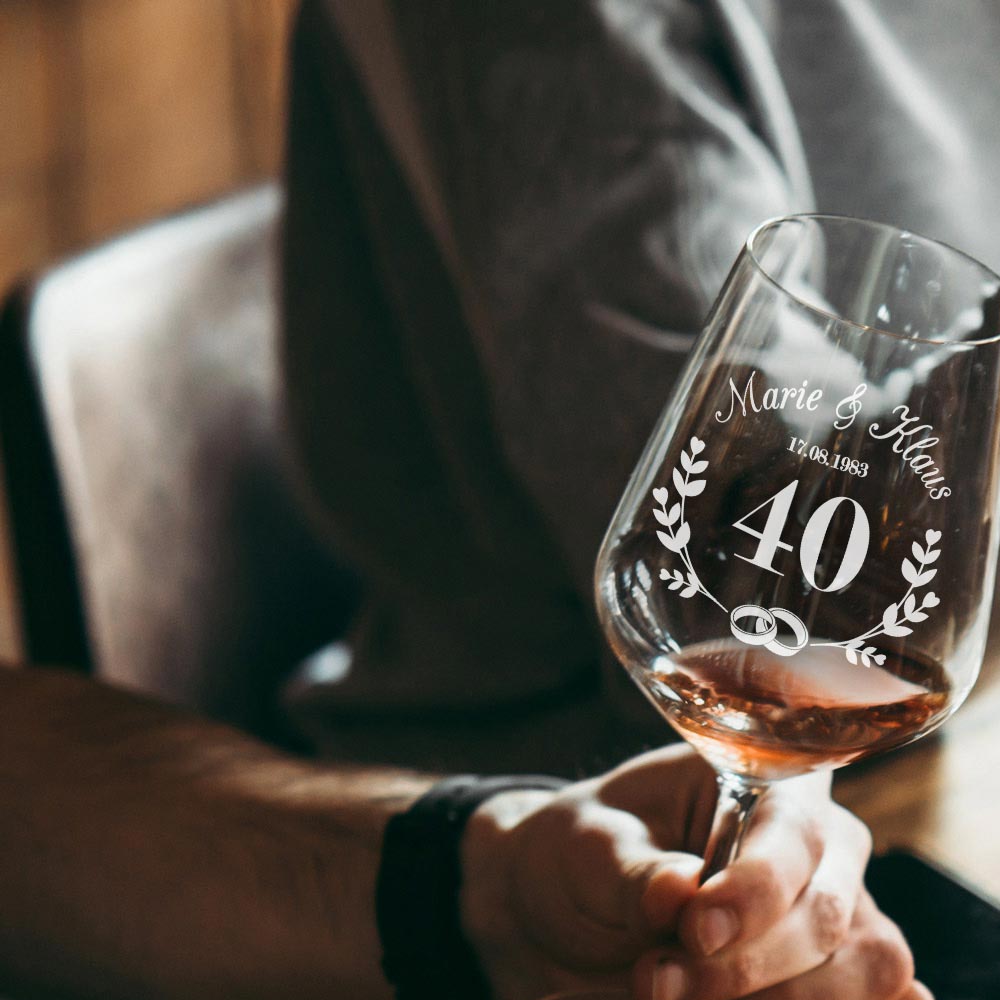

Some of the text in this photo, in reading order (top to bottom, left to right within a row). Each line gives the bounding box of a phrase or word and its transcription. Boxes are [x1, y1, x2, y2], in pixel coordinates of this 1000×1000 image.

[715, 371, 951, 501] Marie & Klaus
[786, 436, 869, 478] 17.08.1983
[732, 479, 870, 593] 40
